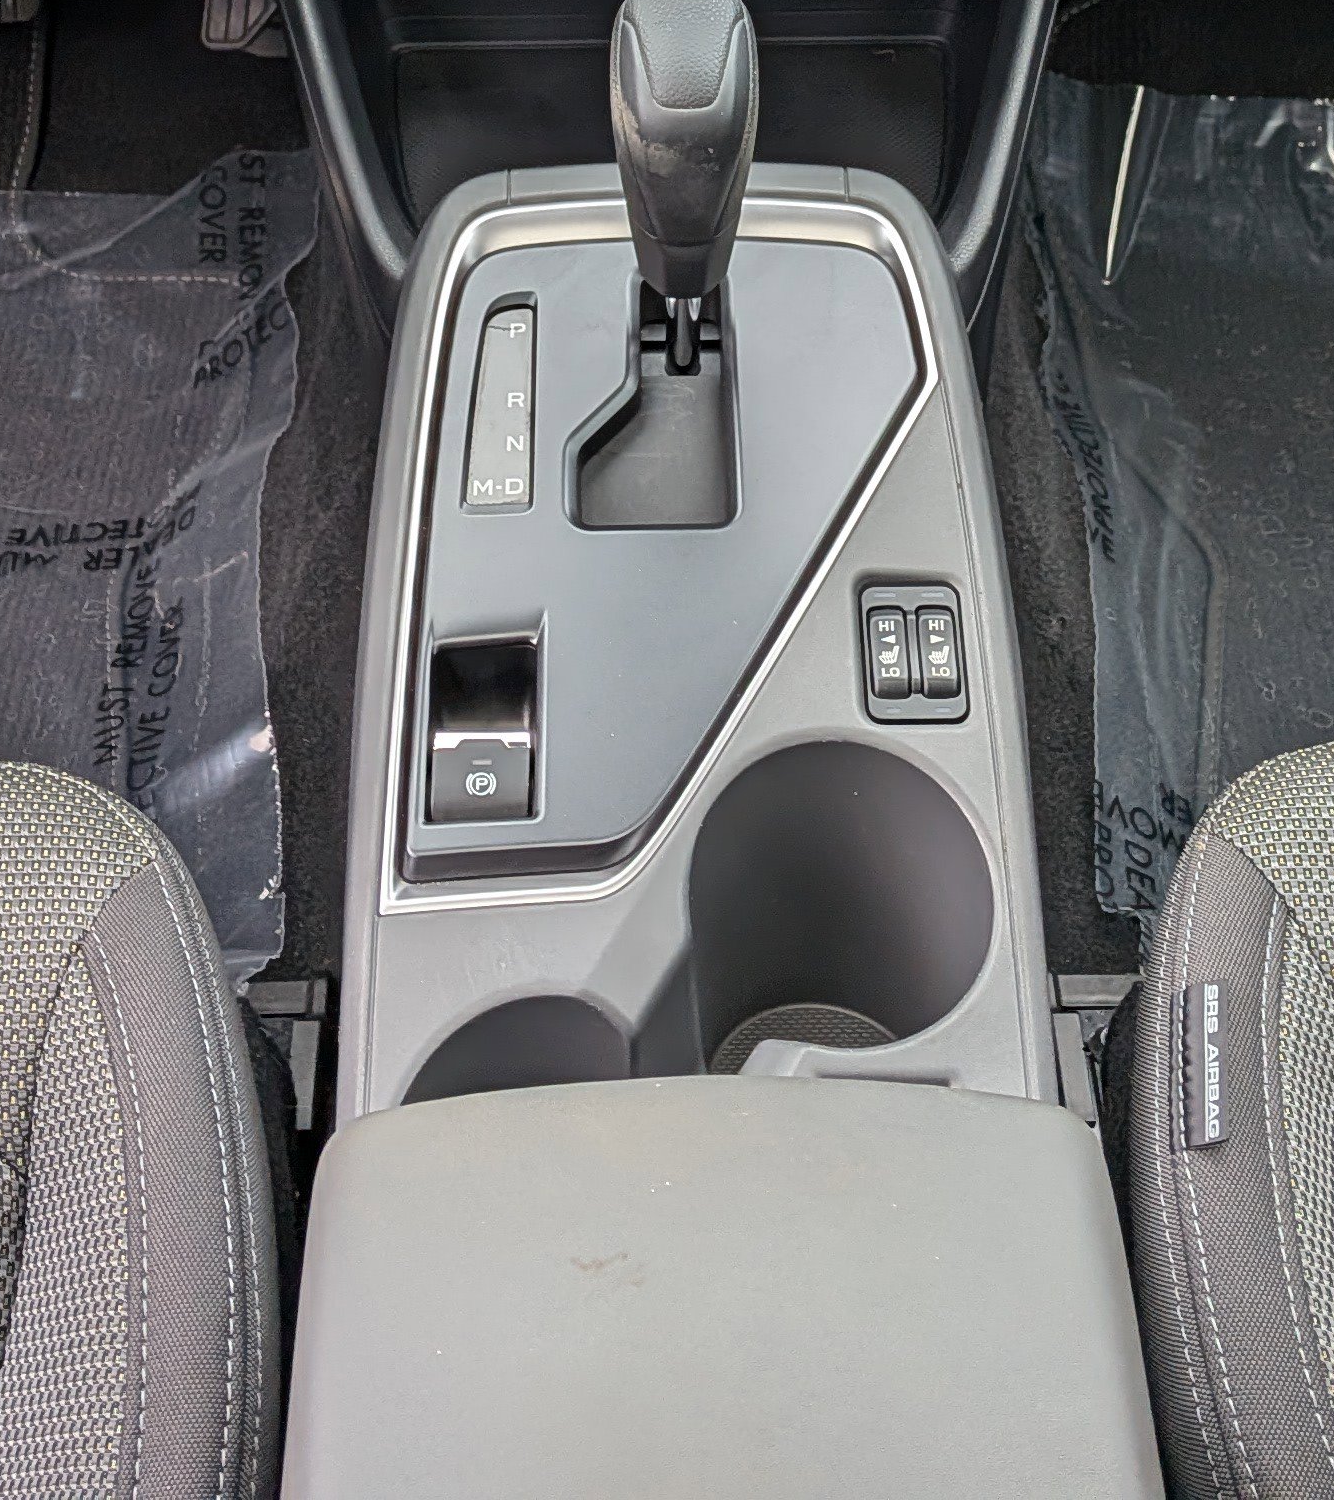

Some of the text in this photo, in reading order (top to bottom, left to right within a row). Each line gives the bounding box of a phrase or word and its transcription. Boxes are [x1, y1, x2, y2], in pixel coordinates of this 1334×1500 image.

[509, 322, 526, 338] P
[507, 392, 525, 408] R
[506, 435, 524, 451] N
[878, 620, 895, 632] HI
[928, 619, 945, 631] HI
[881, 666, 901, 677] LO
[931, 666, 951, 677] LO
[94, 684, 126, 767] MUST
[1206, 983, 1220, 1139] SRS AIRBAG
